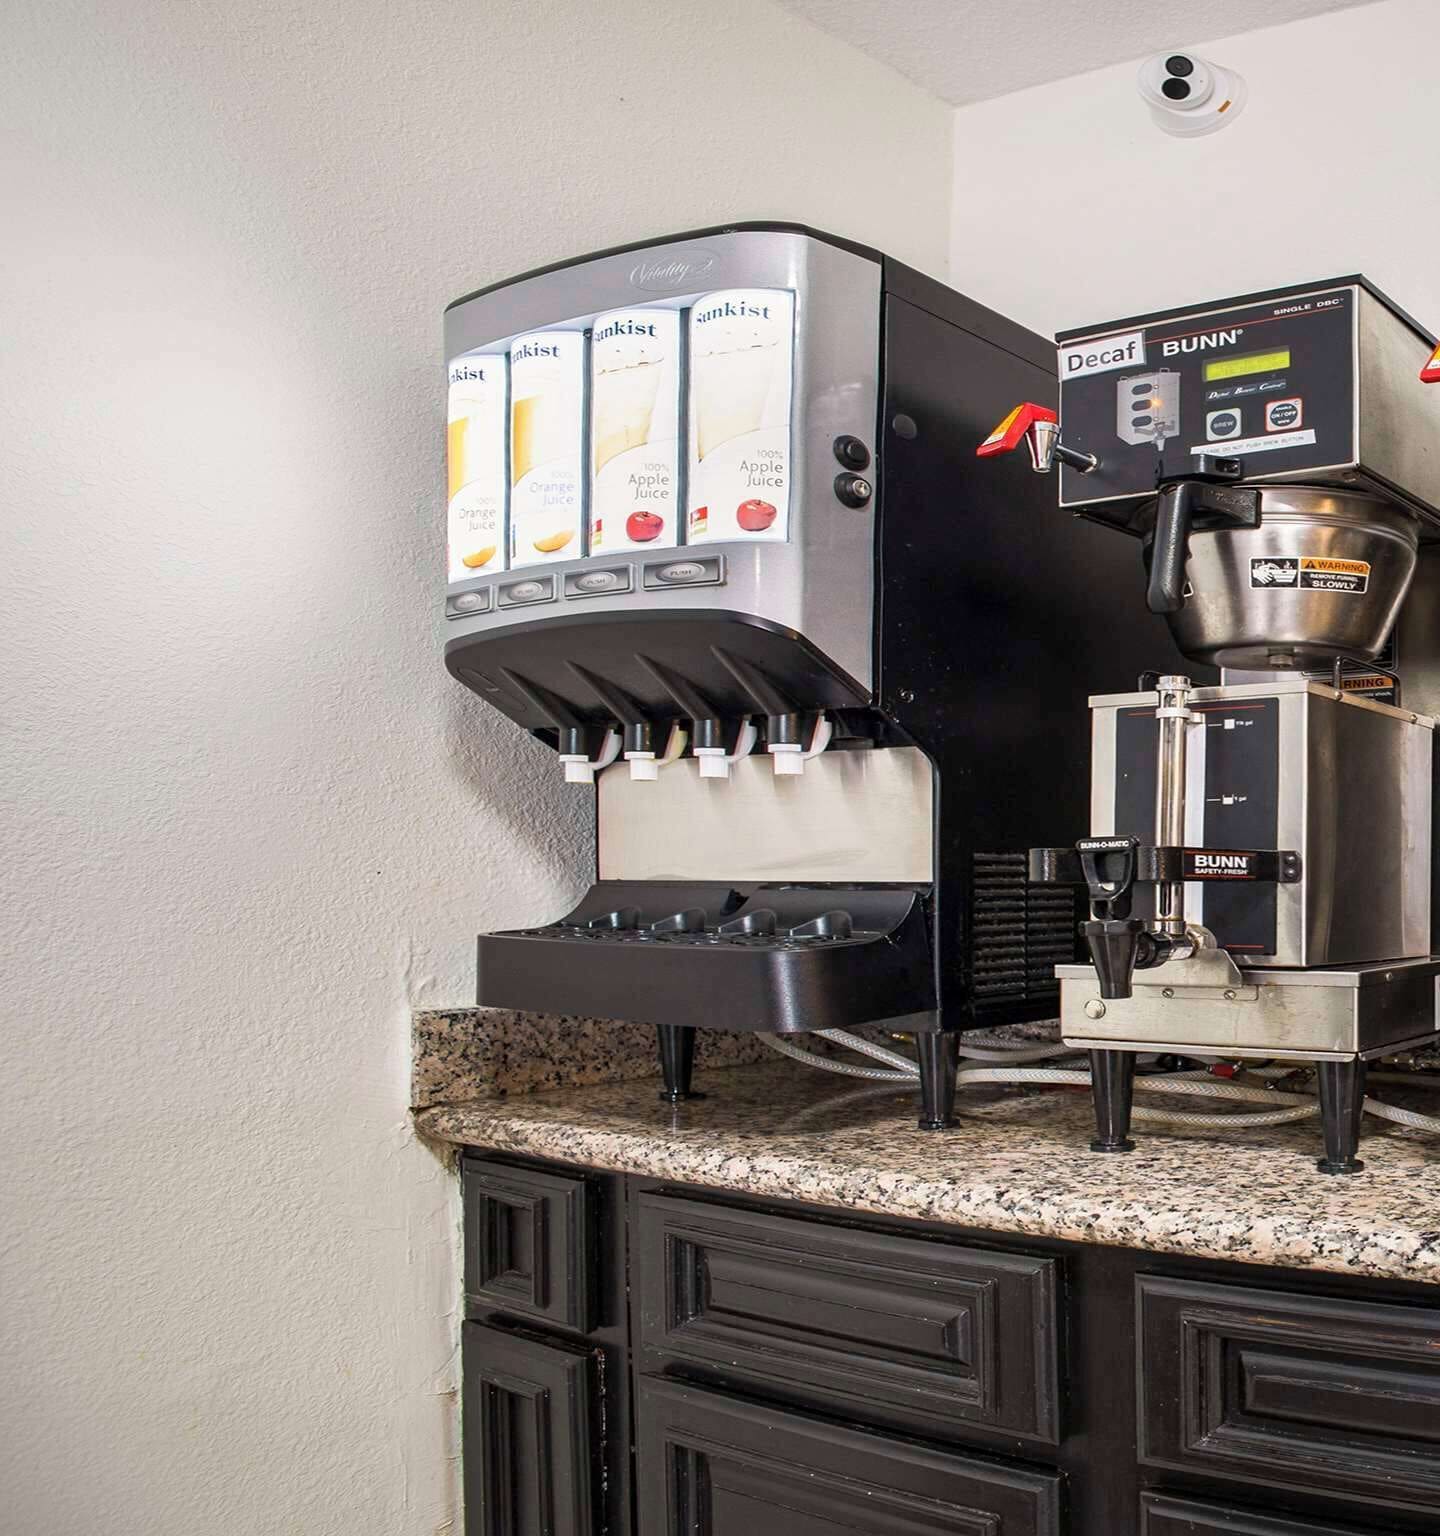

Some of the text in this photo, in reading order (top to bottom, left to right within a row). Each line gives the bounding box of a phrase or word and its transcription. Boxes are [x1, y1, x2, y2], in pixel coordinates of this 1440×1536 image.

[1273, 303, 1312, 316] SINGLE
[1068, 340, 1137, 372] Decaf
[739, 460, 784, 476] Apple
[628, 473, 670, 487] Apple
[747, 474, 784, 488] Juice
[529, 482, 575, 495] Orange
[634, 486, 670, 500] Juice
[543, 495, 575, 506] Juice
[459, 508, 496, 520] Orange
[468, 521, 496, 532] Juice
[1318, 560, 1364, 573] WARNING
[1312, 580, 1357, 590] SLOWLY
[1343, 678, 1384, 689] RNING
[1080, 840, 1130, 849] BUNN-O-MATIC
